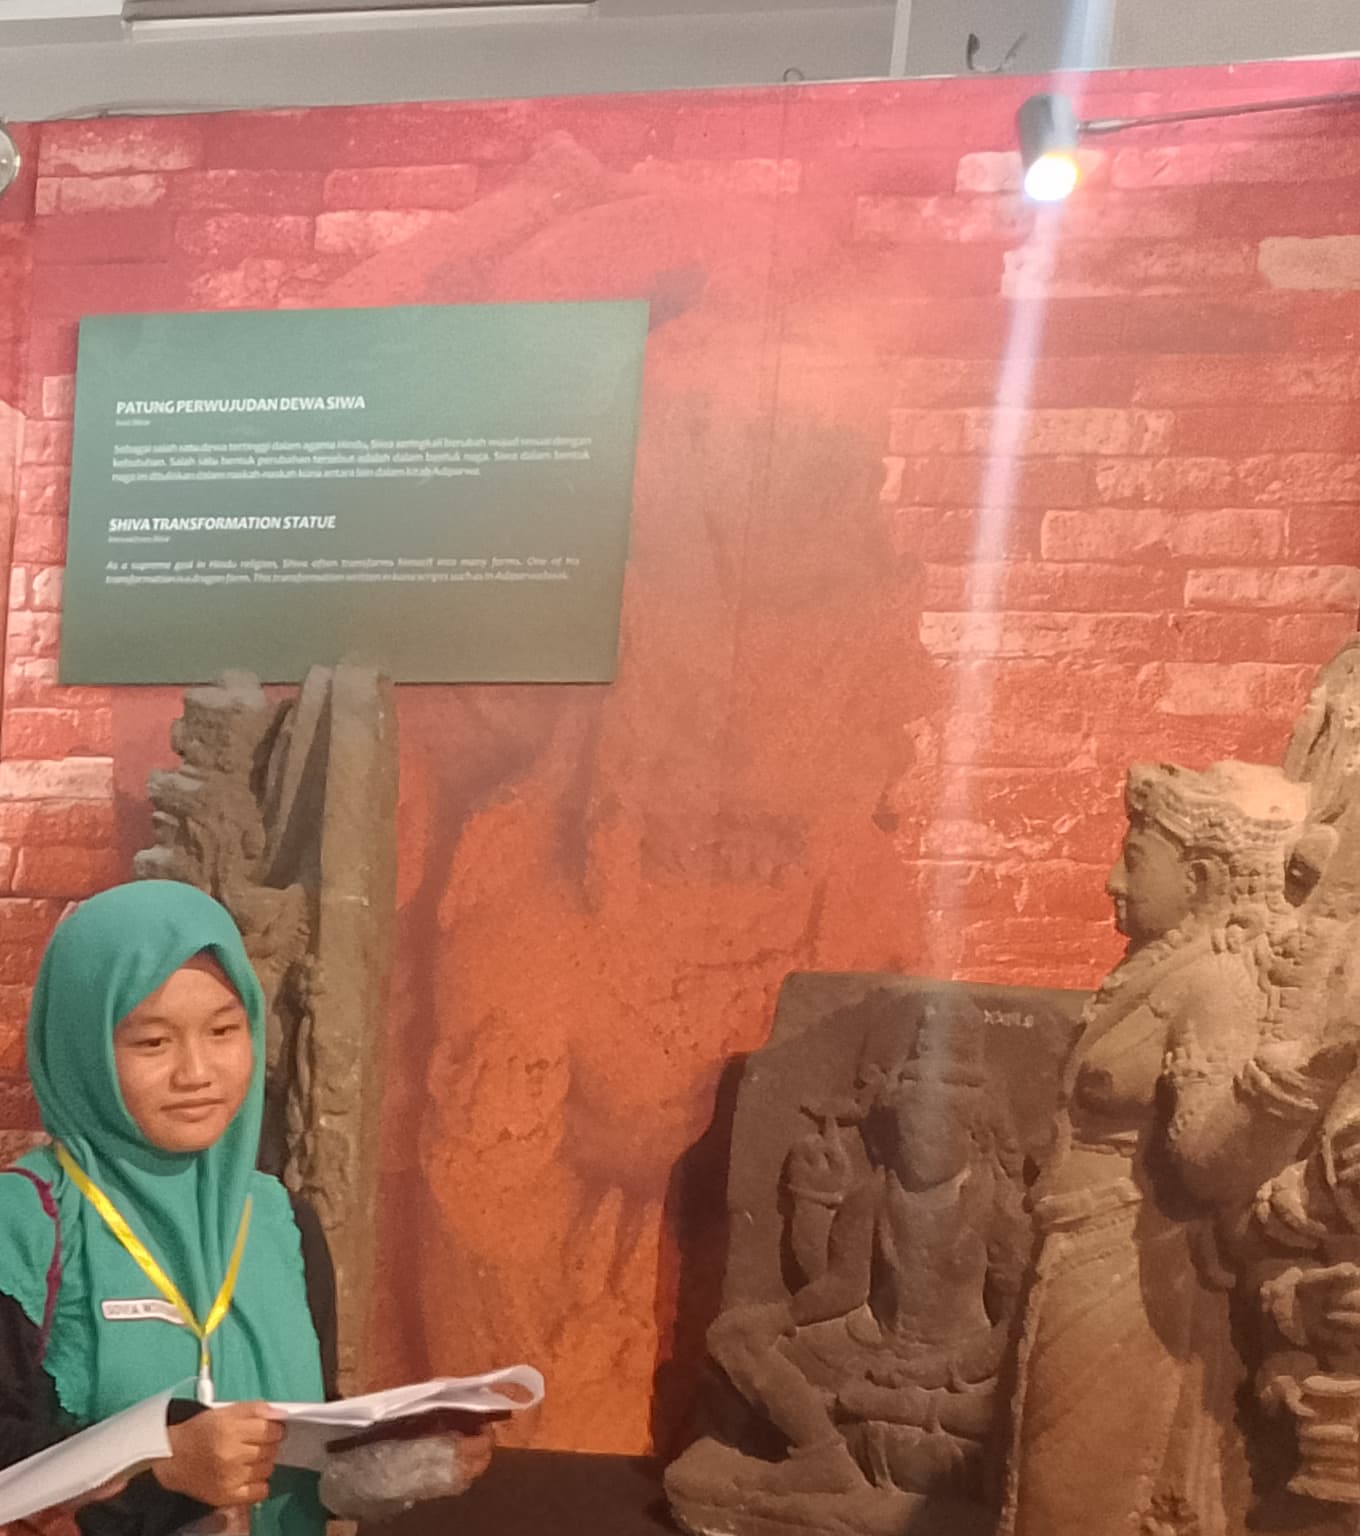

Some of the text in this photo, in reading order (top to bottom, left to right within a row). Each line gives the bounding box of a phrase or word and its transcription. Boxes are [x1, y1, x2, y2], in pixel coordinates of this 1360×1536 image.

[116, 395, 366, 415] PATUNG PERWUJUDAN DEWA SIWA
[109, 515, 337, 532] SHIVA TRANSFORMATION STATUE
